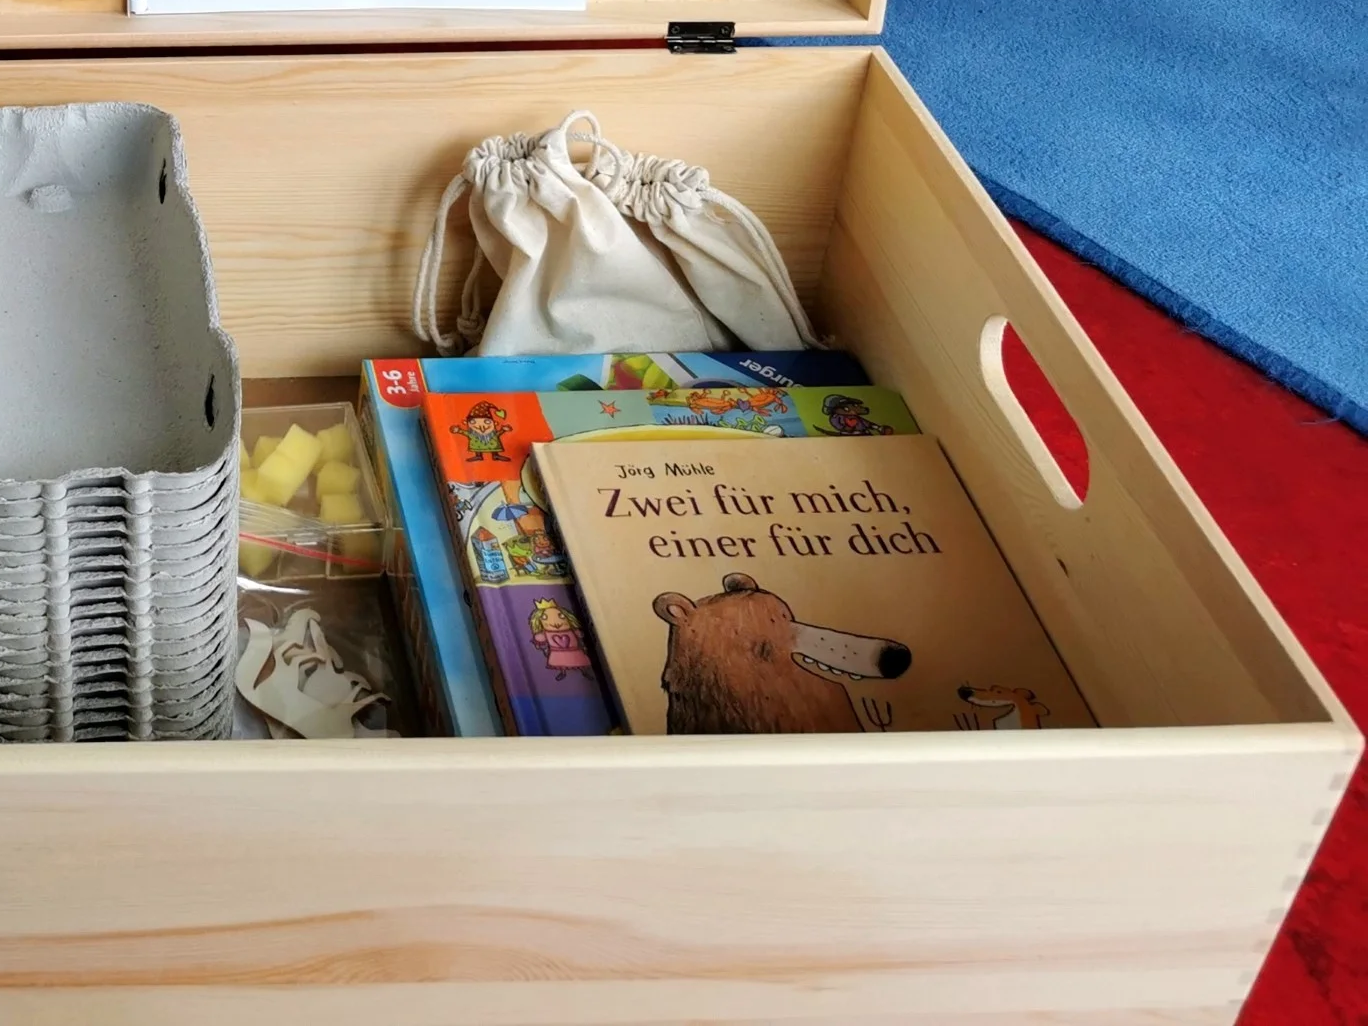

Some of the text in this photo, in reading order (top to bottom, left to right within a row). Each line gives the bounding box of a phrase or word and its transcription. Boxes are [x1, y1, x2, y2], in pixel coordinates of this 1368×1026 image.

[382, 370, 407, 395] 3-6
[406, 371, 421, 393] Jahre
[614, 462, 715, 479] Jörg Mühle
[596, 479, 911, 518] Zwei für mich,
[649, 521, 945, 558] einer für dich
